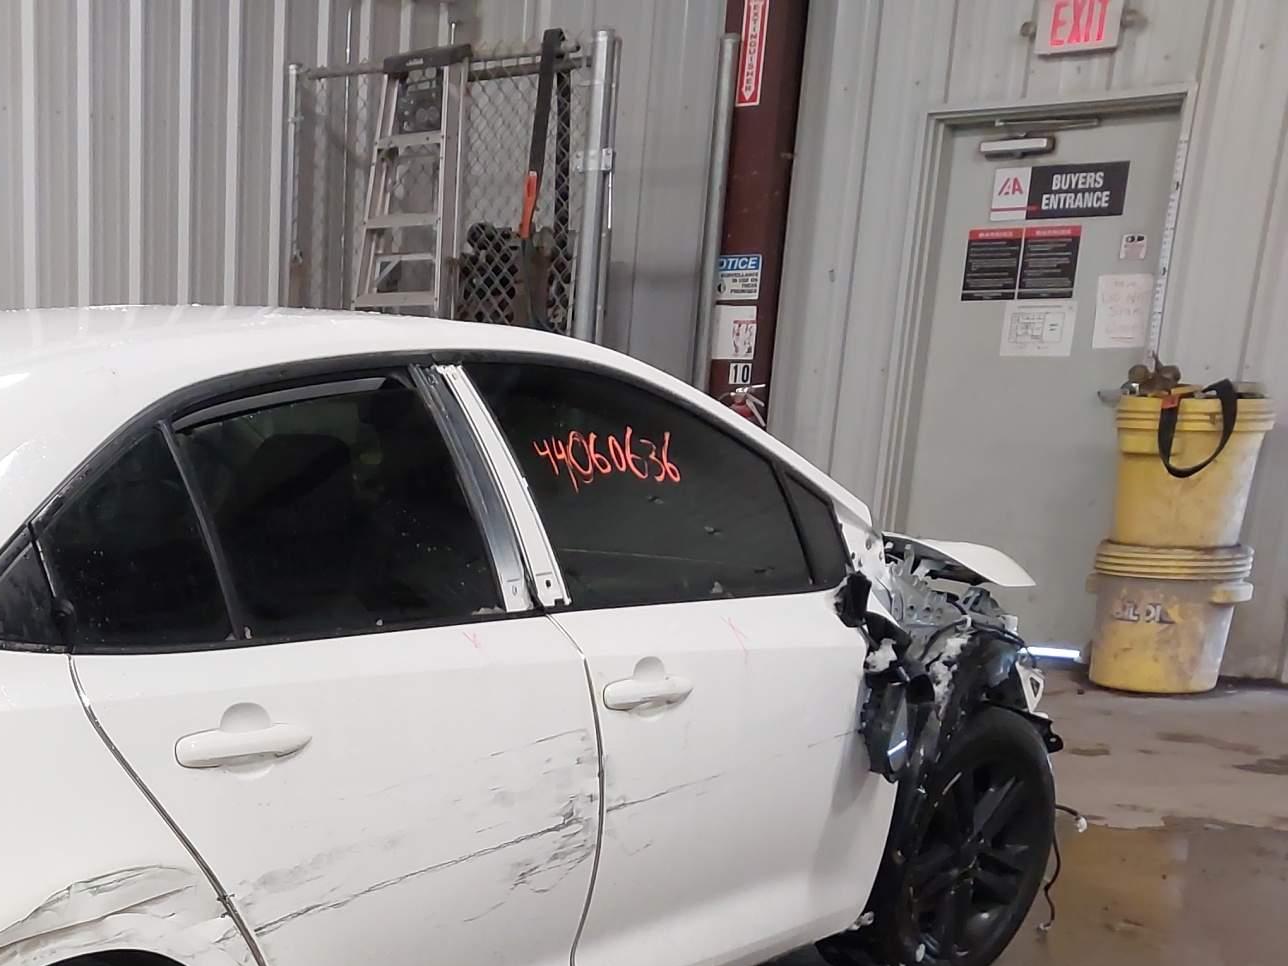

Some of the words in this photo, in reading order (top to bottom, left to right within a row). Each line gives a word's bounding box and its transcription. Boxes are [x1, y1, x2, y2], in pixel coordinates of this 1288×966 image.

[1049, 0, 1110, 46] EXIT
[1052, 171, 1104, 190] BUYERS
[1041, 191, 1110, 210] ENTRANCE
[720, 257, 758, 269] OTICE
[733, 364, 750, 383] 10
[533, 426, 680, 493] 44060636
